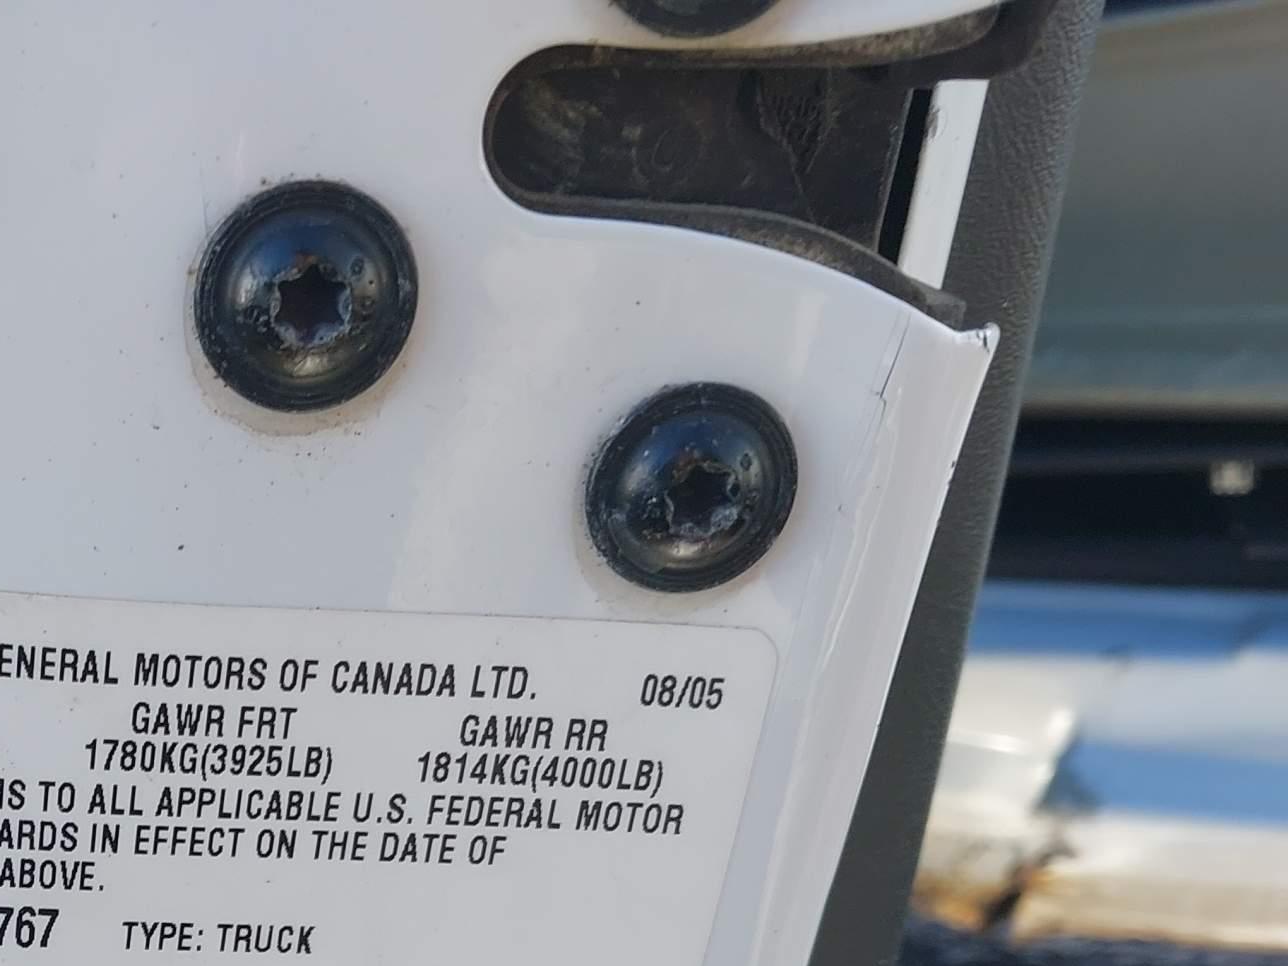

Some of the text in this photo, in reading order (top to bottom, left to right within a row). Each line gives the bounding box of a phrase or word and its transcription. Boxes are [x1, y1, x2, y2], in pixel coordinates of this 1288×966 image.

[134, 653, 267, 691] MOTORS
[279, 659, 319, 692] OF
[331, 661, 455, 697] CANADA
[470, 665, 536, 700] LTD.
[640, 674, 725, 710] 08/05
[132, 702, 298, 740] GAWR FRT
[460, 714, 608, 751] GAWR RR
[85, 738, 332, 785] 1780KG(3925LB)
[418, 751, 663, 797] 1814KG(4000LB)
[38, 781, 75, 813] TO
[88, 784, 143, 816] ALL
[155, 786, 341, 822] APPLICABLE
[353, 792, 412, 824] U.S.
[427, 795, 561, 829] FEDERAL
[575, 800, 684, 835] MOTOR
[90, 823, 120, 854] IN
[134, 825, 245, 857] EFFECT
[256, 829, 297, 859] ON
[312, 830, 368, 861] THE
[379, 832, 457, 864] DATE
[468, 835, 507, 865] OF
[122, 921, 316, 954] TYPE: TRUCK
